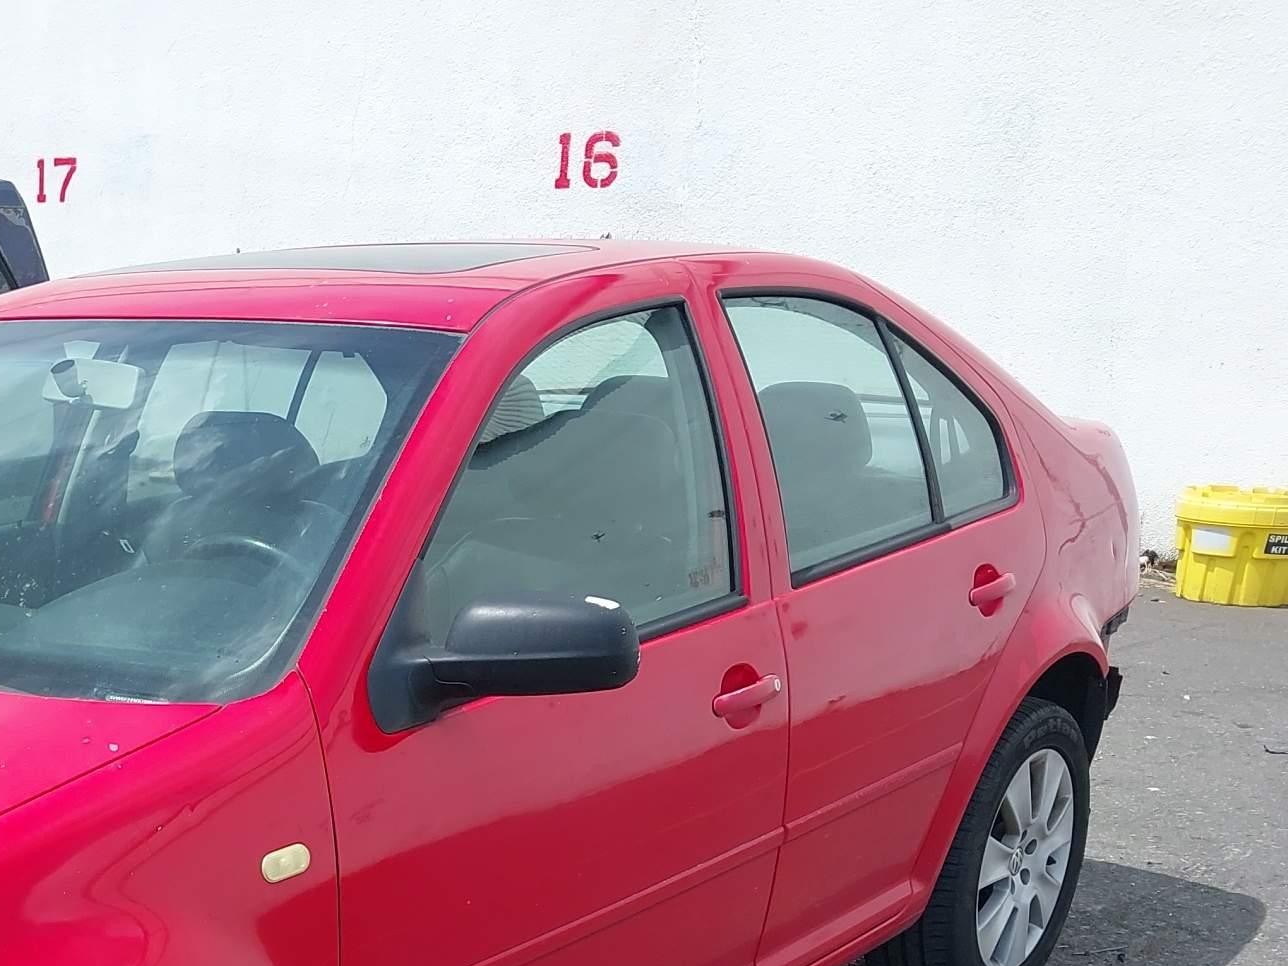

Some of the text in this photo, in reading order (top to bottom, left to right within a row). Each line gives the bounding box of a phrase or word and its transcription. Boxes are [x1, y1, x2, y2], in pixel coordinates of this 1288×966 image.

[35, 157, 78, 203] 17
[554, 131, 620, 189] 16
[1270, 545, 1287, 554] KIT
